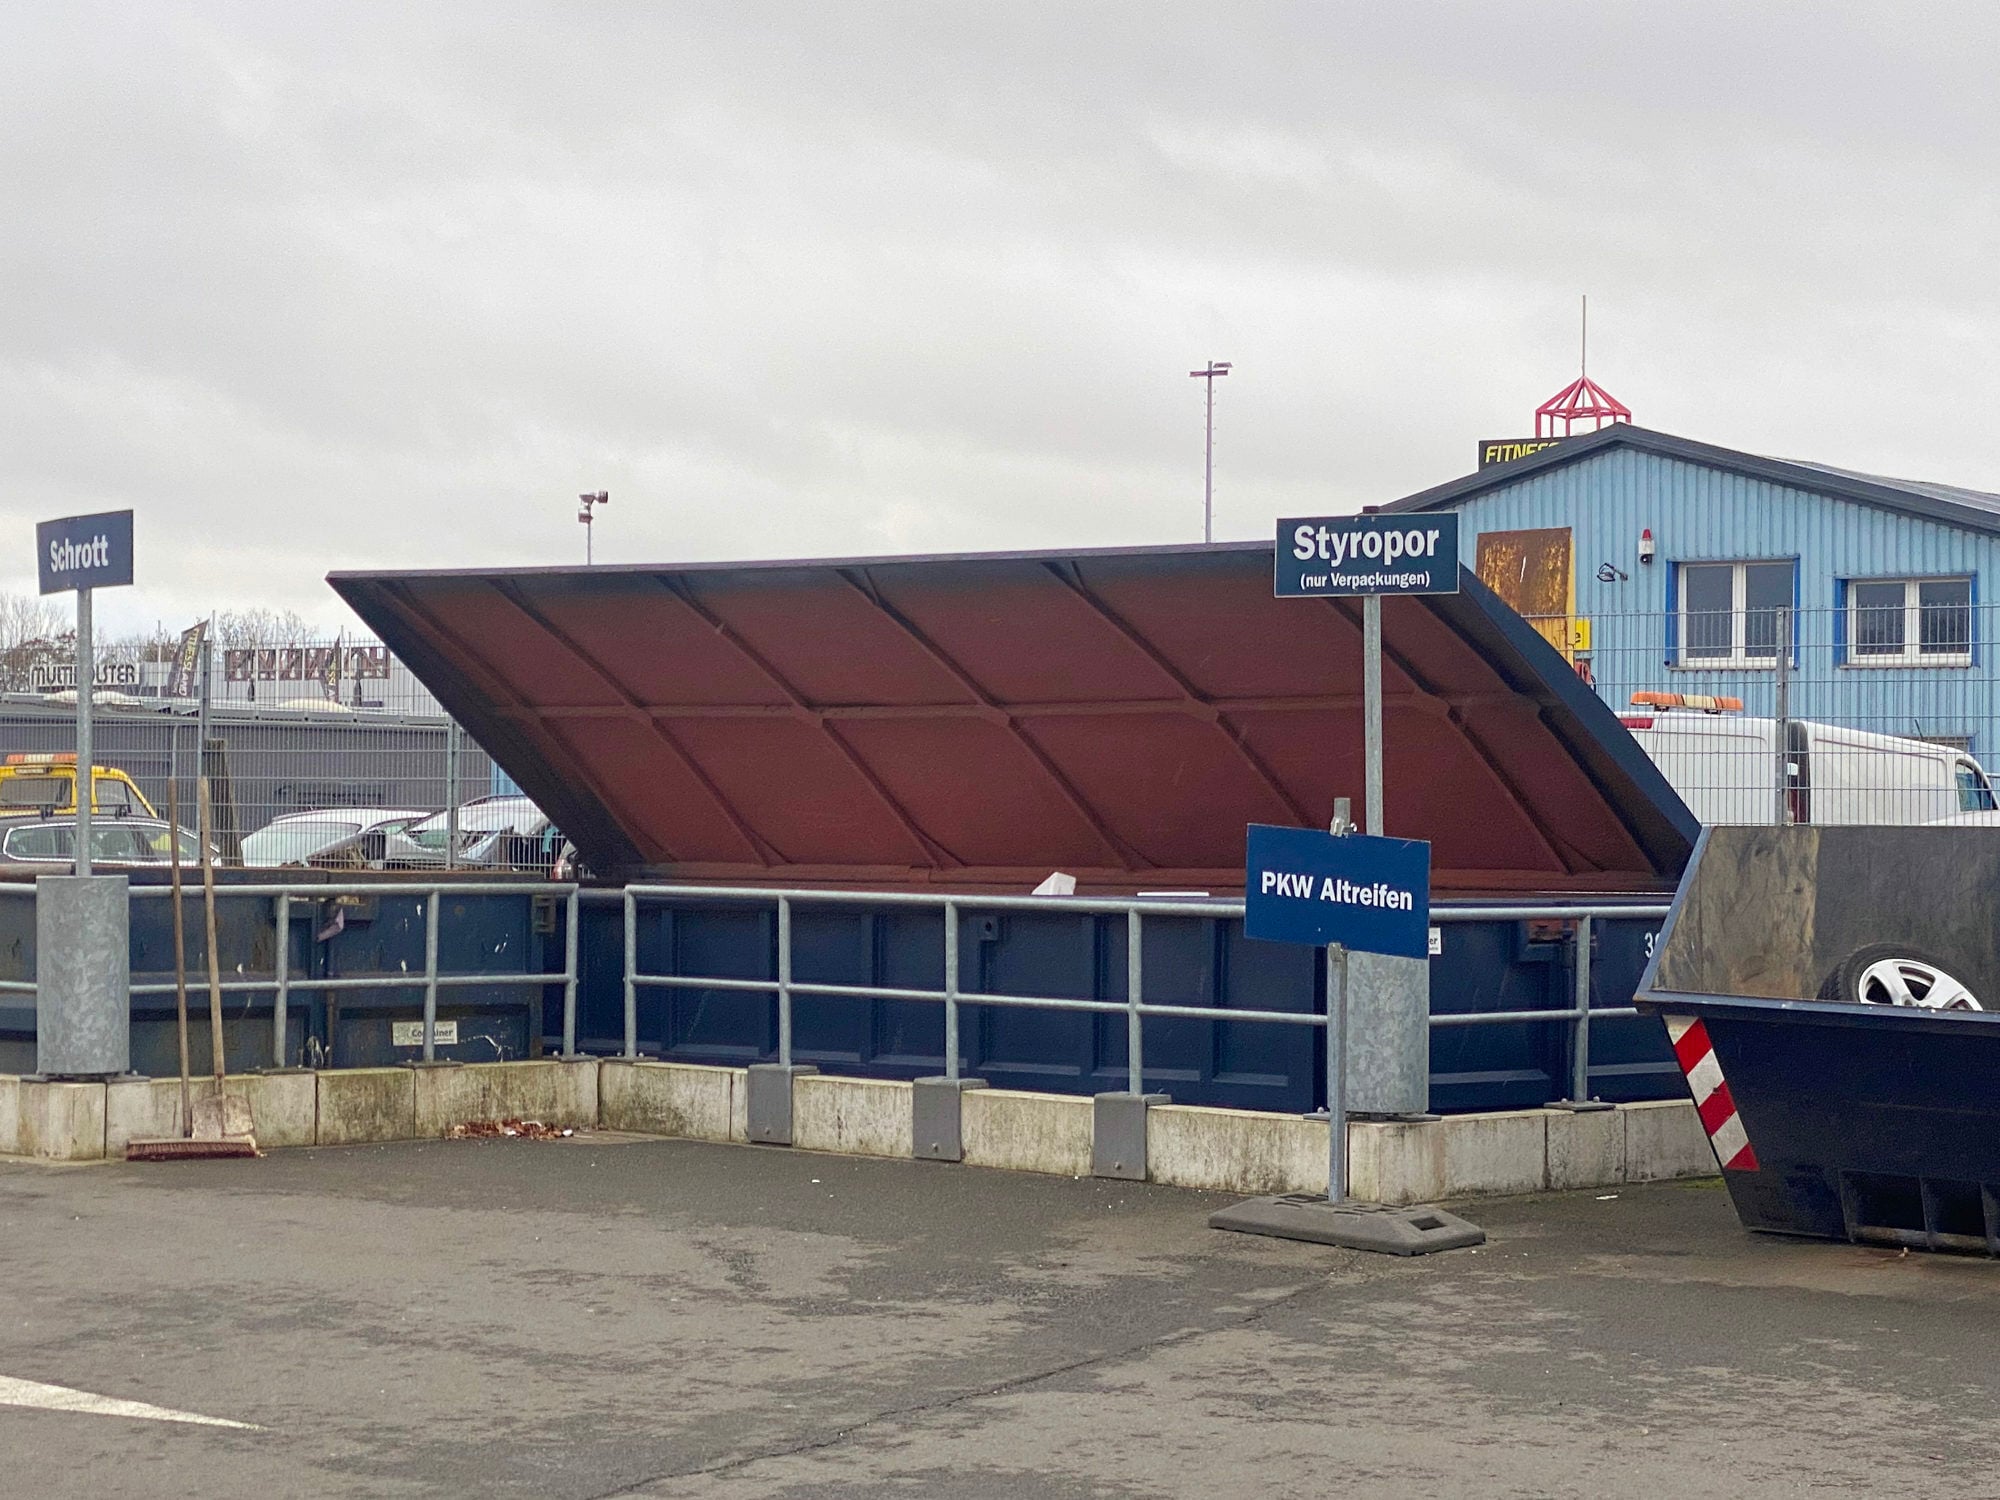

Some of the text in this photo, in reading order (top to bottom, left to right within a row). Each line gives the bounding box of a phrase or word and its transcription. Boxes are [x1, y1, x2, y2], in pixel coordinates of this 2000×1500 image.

[1485, 442, 1560, 463] FITNE
[50, 534, 109, 573] Schrott
[1293, 525, 1440, 567] Styropor
[1300, 571, 1430, 589] (nur Verpackungen)
[1261, 871, 1413, 911] PKW Altreifen
